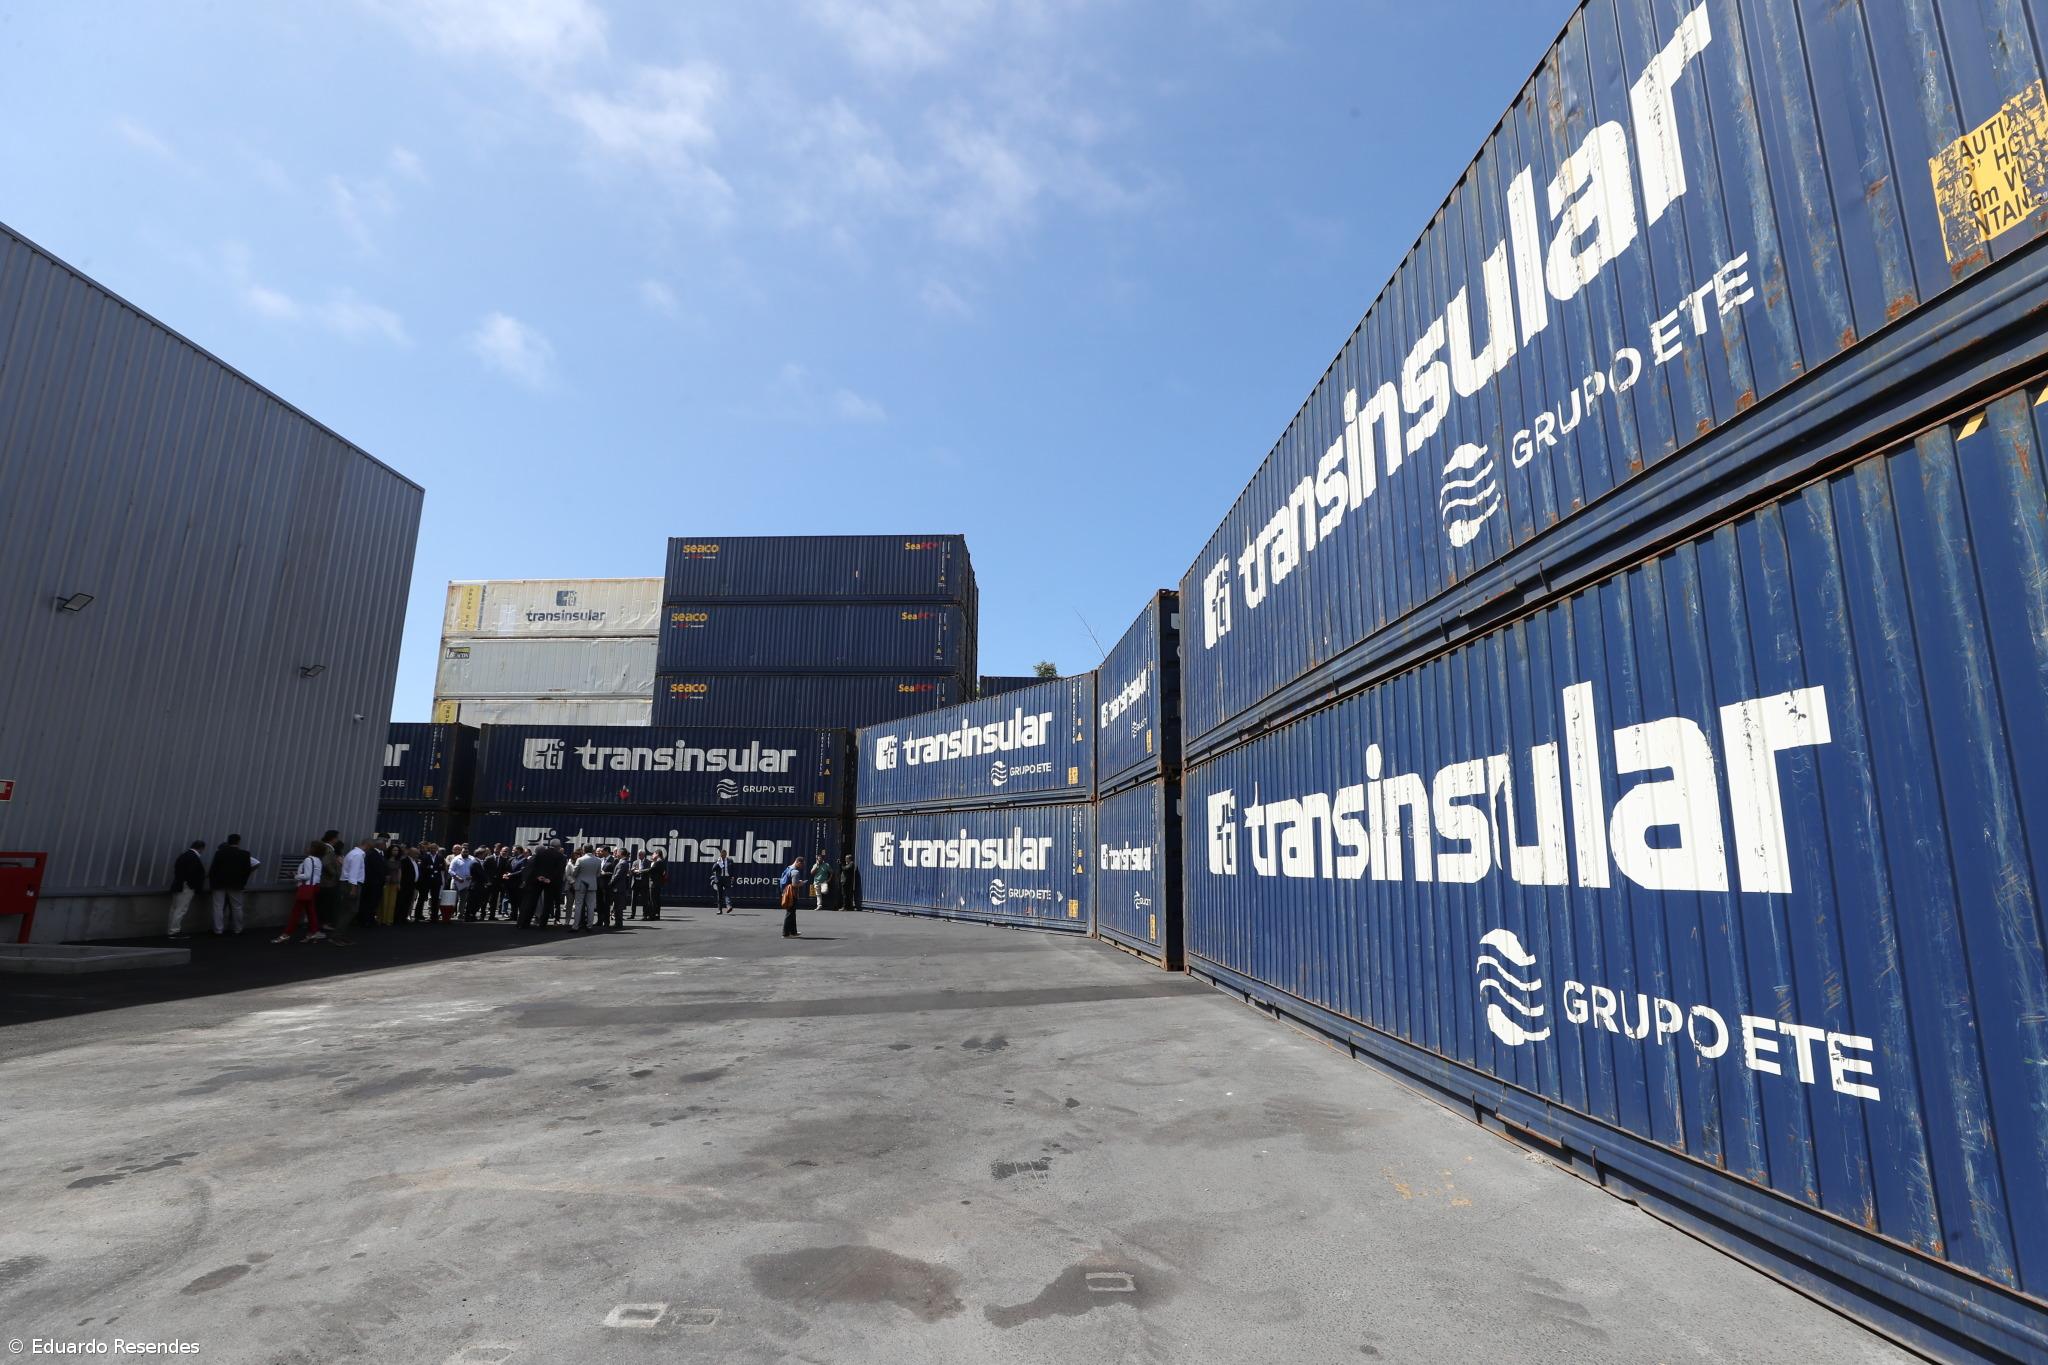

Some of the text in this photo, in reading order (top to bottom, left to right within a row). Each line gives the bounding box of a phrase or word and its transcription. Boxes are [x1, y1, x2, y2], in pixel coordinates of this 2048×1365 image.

[1237, 4, 1712, 610] transinsular
[1511, 252, 1755, 470] GRUPO ETE
[683, 544, 719, 553] seaco
[526, 609, 606, 622] transinsular
[671, 612, 708, 622] seaco
[670, 683, 707, 693] seaco
[902, 707, 1053, 766] transinsular
[574, 738, 797, 773] transinsular
[1009, 762, 1052, 777] GRUPO ETE
[743, 785, 795, 794] GRUPO ETE
[1244, 681, 1831, 894] transinsular
[899, 826, 1053, 871] transinsular
[736, 877, 770, 885] GRUPO
[1008, 888, 1052, 900] GRUPO ETE
[1563, 979, 1880, 1101] GRUPO ETE
